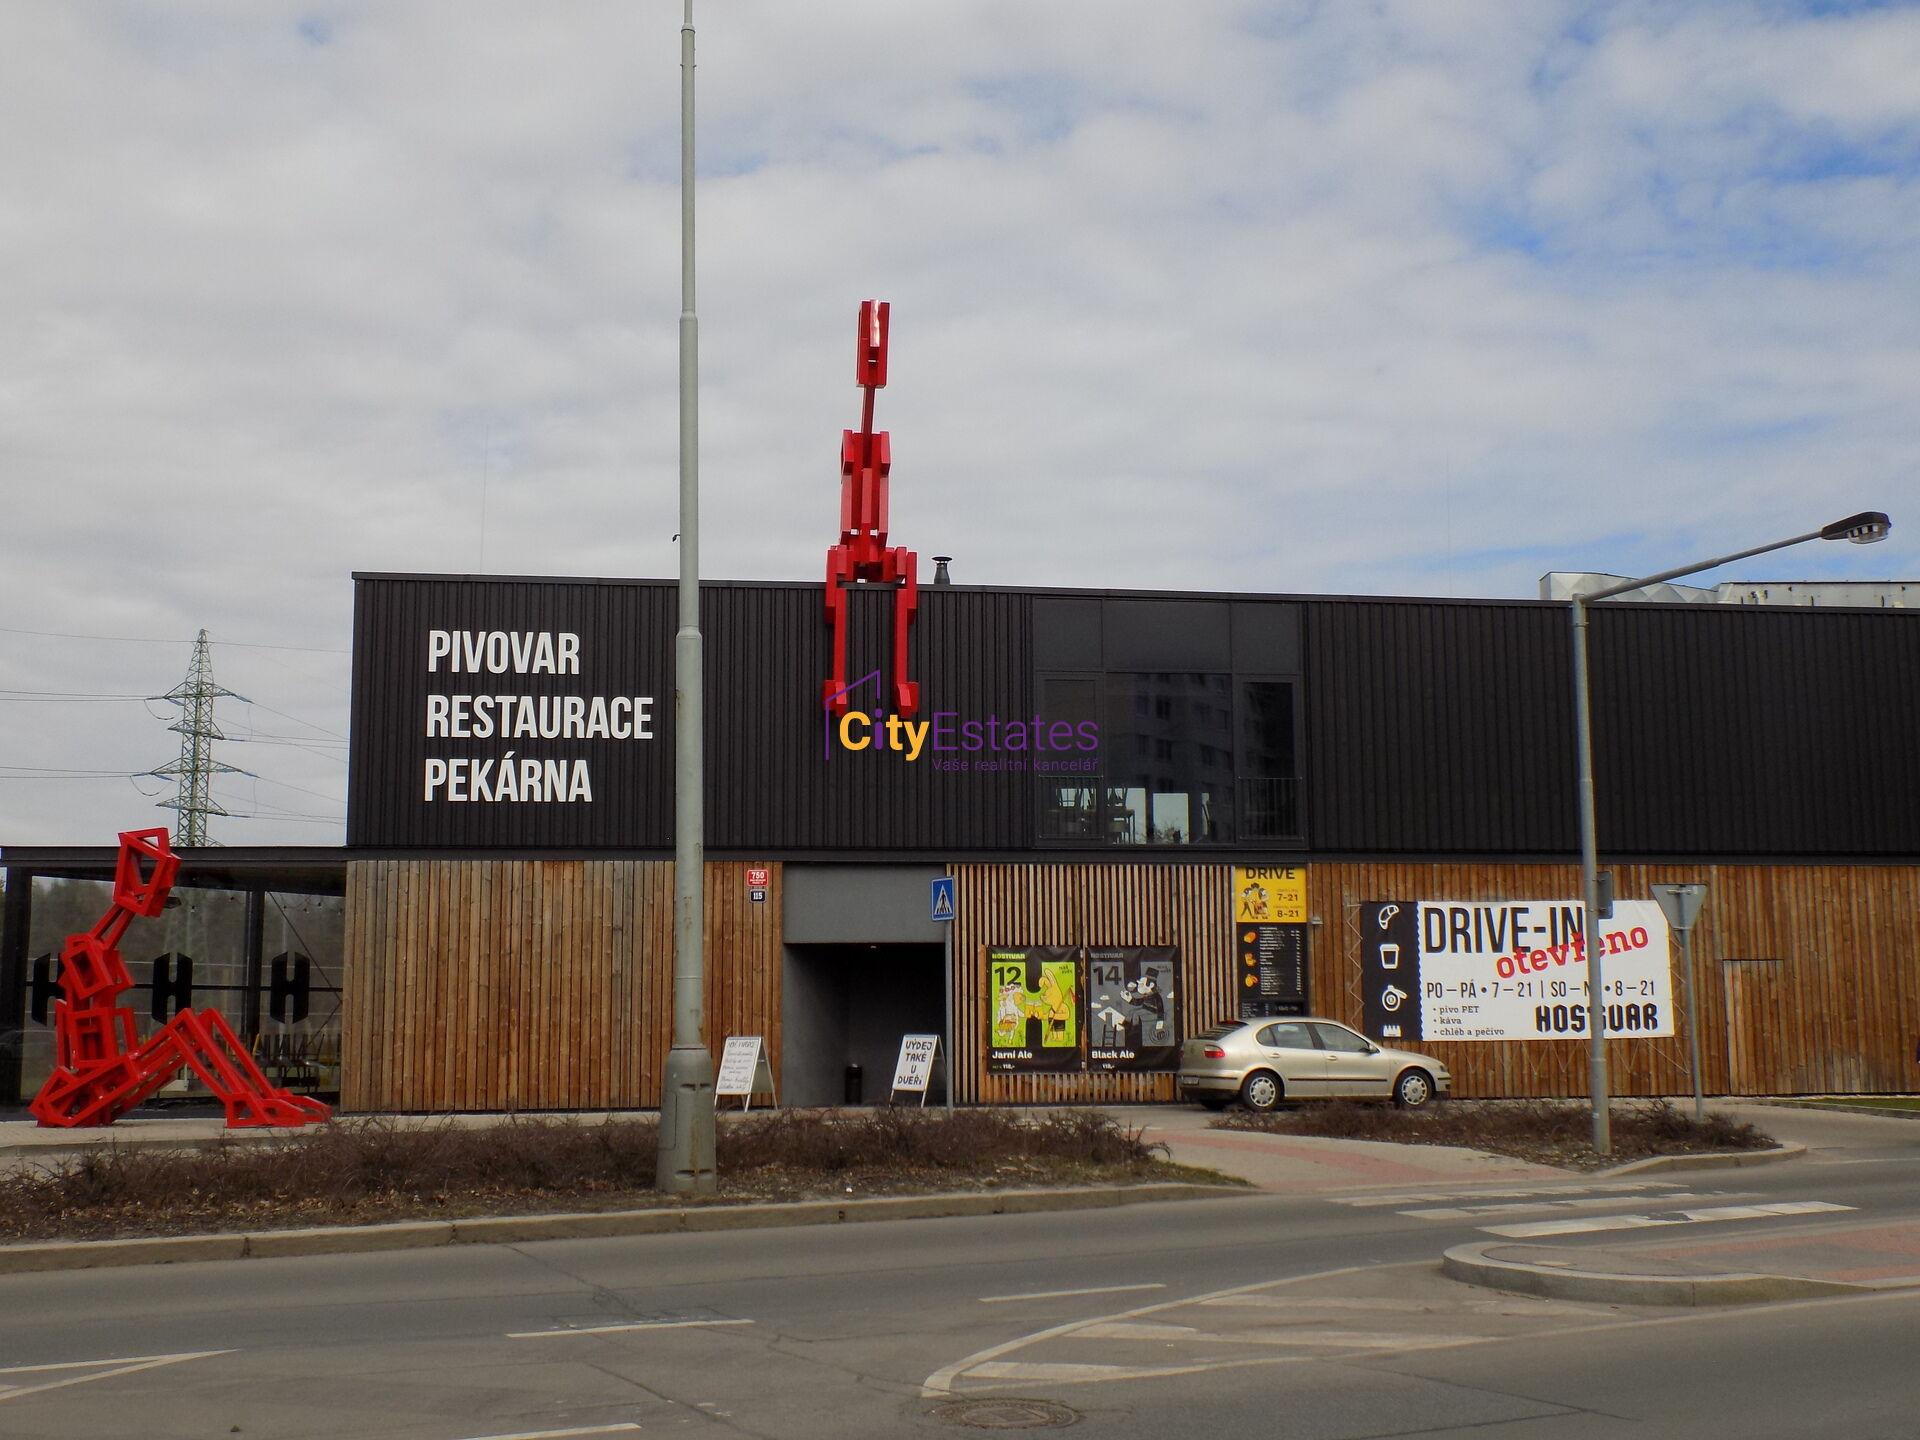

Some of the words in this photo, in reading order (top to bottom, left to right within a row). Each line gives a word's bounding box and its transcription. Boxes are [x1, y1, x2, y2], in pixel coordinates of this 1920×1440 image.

[428, 630, 580, 675] PIVOVAR
[426, 695, 654, 740] RESTAURACE
[424, 751, 593, 803] PEKÁRNA
[1245, 866, 1295, 880] DRIVE
[1423, 906, 1584, 954] DRIVE-IN
[994, 966, 1021, 986] 12
[1093, 966, 1121, 986] 14
[1427, 982, 1443, 999] PO
[1439, 1006, 1459, 1014] pivo
[1461, 1005, 1480, 1013] PET
[1439, 1016, 1462, 1025] káva
[1440, 1027, 1465, 1036] chléb
[1475, 1027, 1505, 1037] pečivo
[905, 1051, 927, 1062] TAKÉ
[992, 1050, 1016, 1059] Jarní
[1017, 1050, 1033, 1059] Ale
[1091, 1050, 1118, 1059] Black
[1119, 1050, 1135, 1059] Ale
[910, 1065, 917, 1074] U
